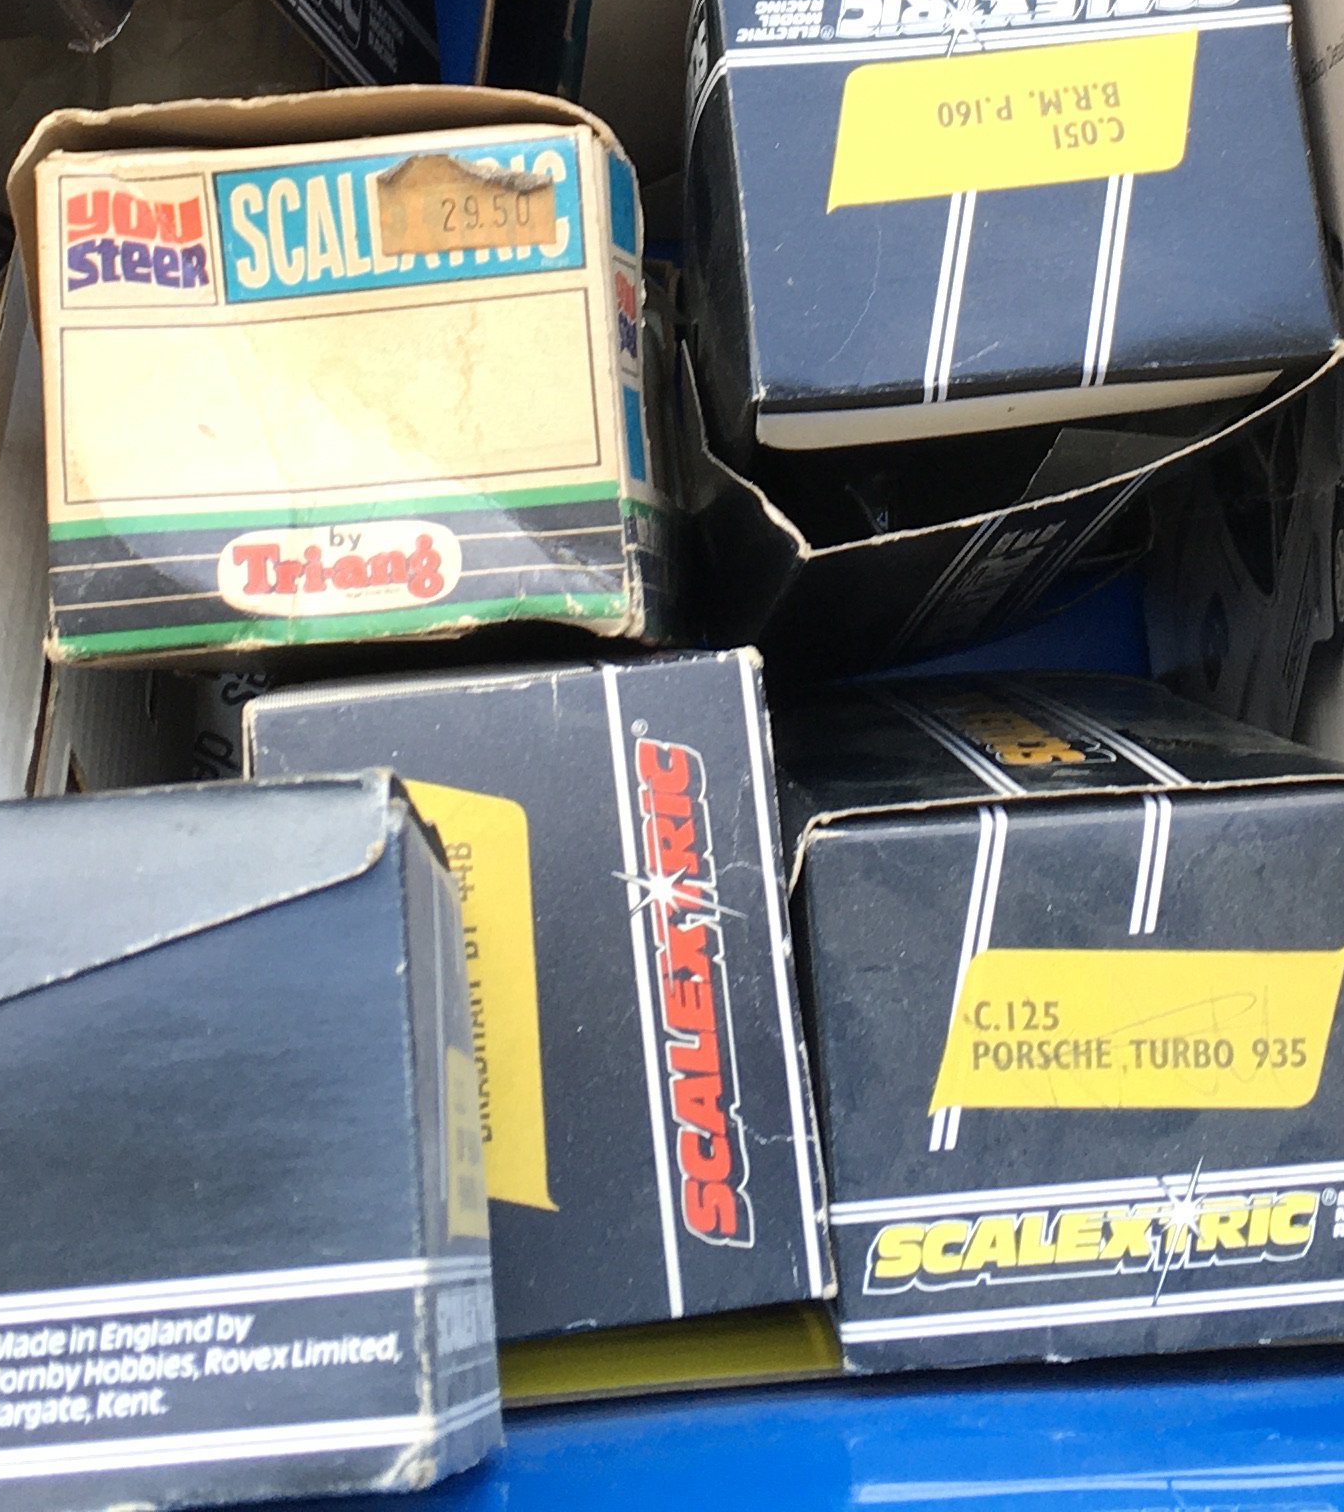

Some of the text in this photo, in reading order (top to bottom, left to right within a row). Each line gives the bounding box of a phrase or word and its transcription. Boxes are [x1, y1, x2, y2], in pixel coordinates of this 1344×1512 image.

[736, 25, 822, 43] ELECTRIC
[757, 13, 823, 28] MODEL
[937, 95, 1013, 128] P.160
[1052, 117, 1125, 151] C.051
[441, 192, 533, 234] 29.50
[329, 525, 362, 552] by
[635, 738, 754, 1248] SCALEXTRIC
[973, 1000, 1061, 1032] C.125
[971, 1038, 1309, 1071] PORSCHE TURBO 935
[863, 1190, 1320, 1295] SCALEXTRIC
[68, 1324, 97, 1352] in
[100, 1316, 215, 1351] England
[216, 1314, 255, 1345] by
[83, 1352, 201, 1387] Hobbies,
[205, 1346, 287, 1374] Rovex
[292, 1331, 403, 1369] Limited,
[96, 1388, 169, 1418] Kent.
